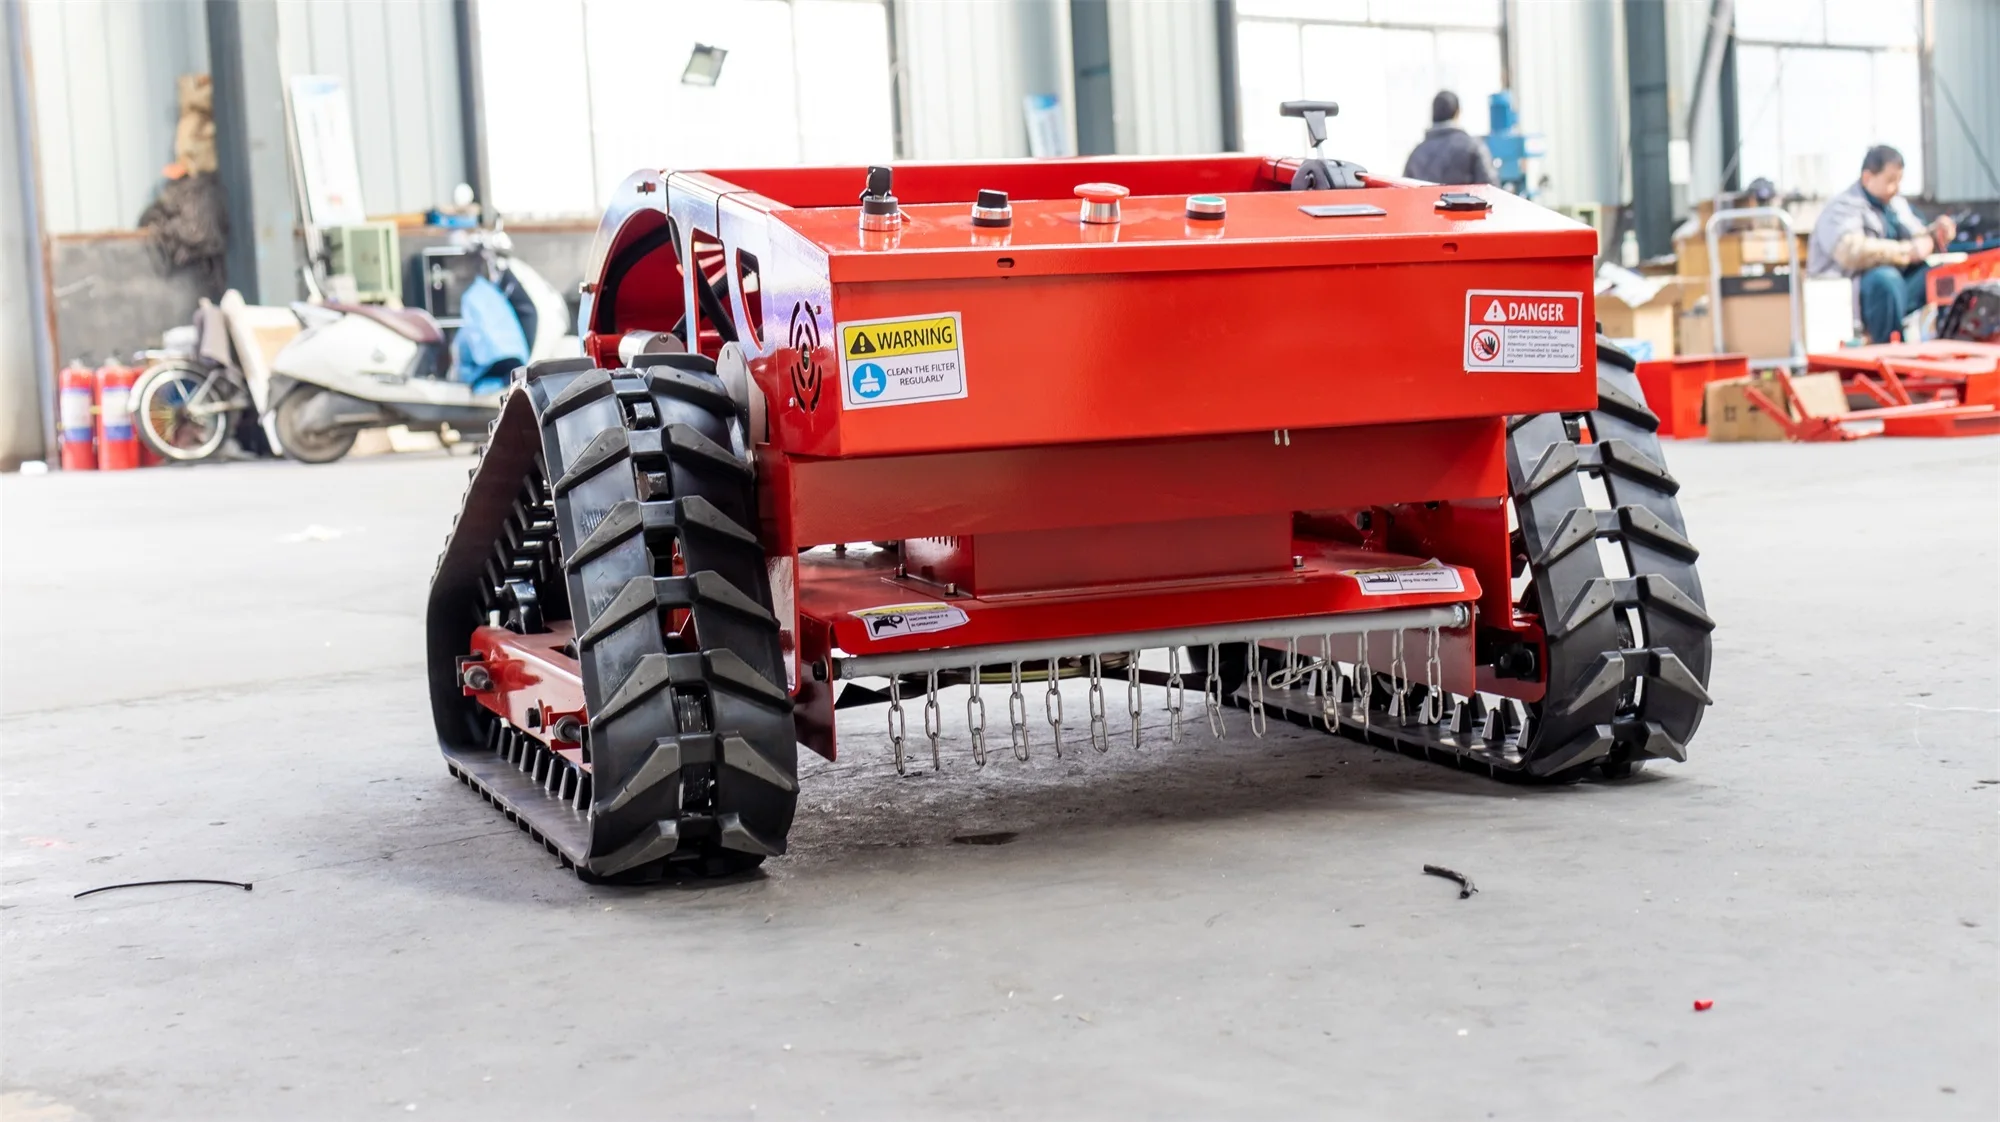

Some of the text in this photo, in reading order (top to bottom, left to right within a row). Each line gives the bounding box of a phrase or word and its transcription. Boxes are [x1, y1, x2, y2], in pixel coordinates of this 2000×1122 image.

[1509, 302, 1564, 321] DANGER
[877, 326, 952, 350] WARNING
[887, 367, 912, 376] CLEAN
[932, 362, 956, 372] FILTER
[900, 374, 944, 385] REGULARLY
